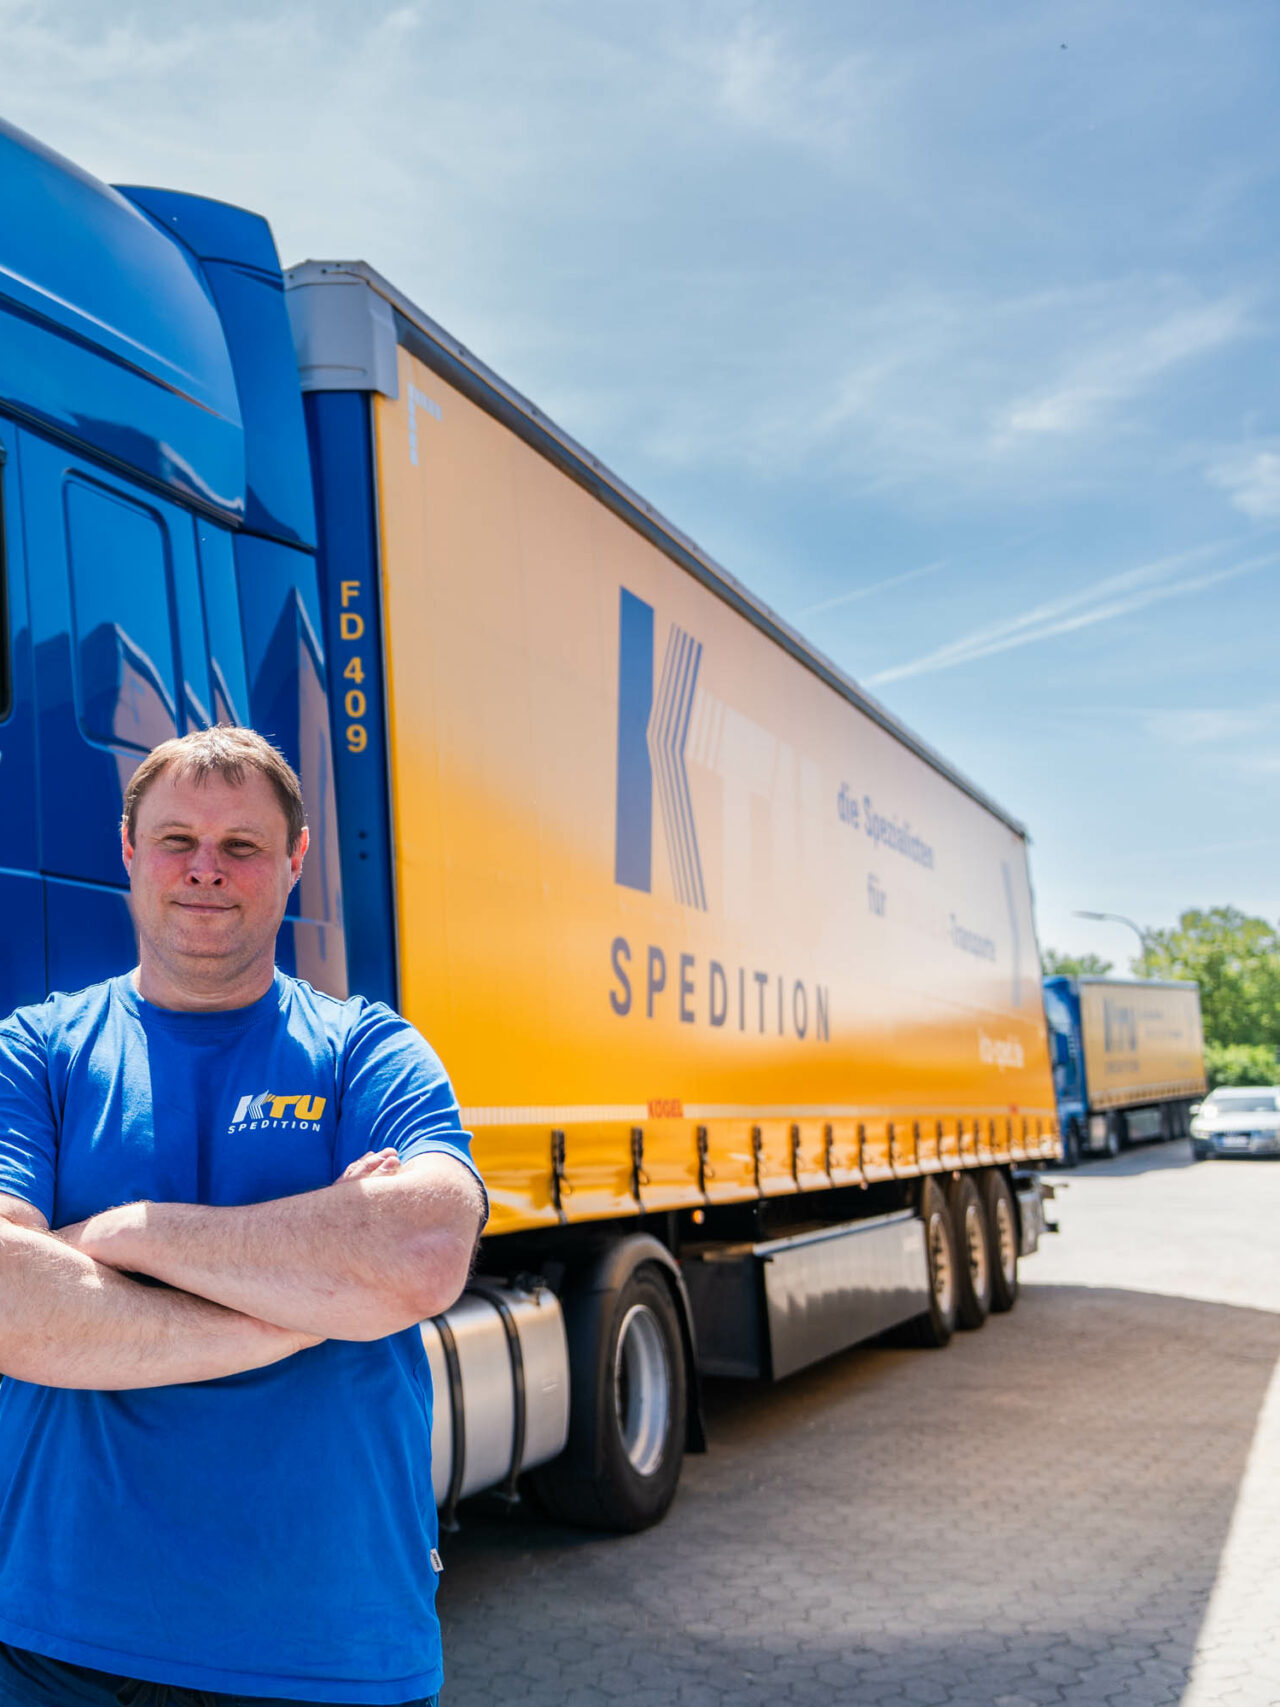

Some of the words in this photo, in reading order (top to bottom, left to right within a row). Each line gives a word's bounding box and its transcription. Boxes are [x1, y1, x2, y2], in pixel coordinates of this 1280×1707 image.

[340, 580, 365, 640] FD
[343, 656, 368, 753] 409
[837, 781, 860, 829] die
[609, 936, 830, 1042] SPEDITION
[227, 1119, 321, 1134] SPEDITION
[231, 1089, 326, 1123] KTU
